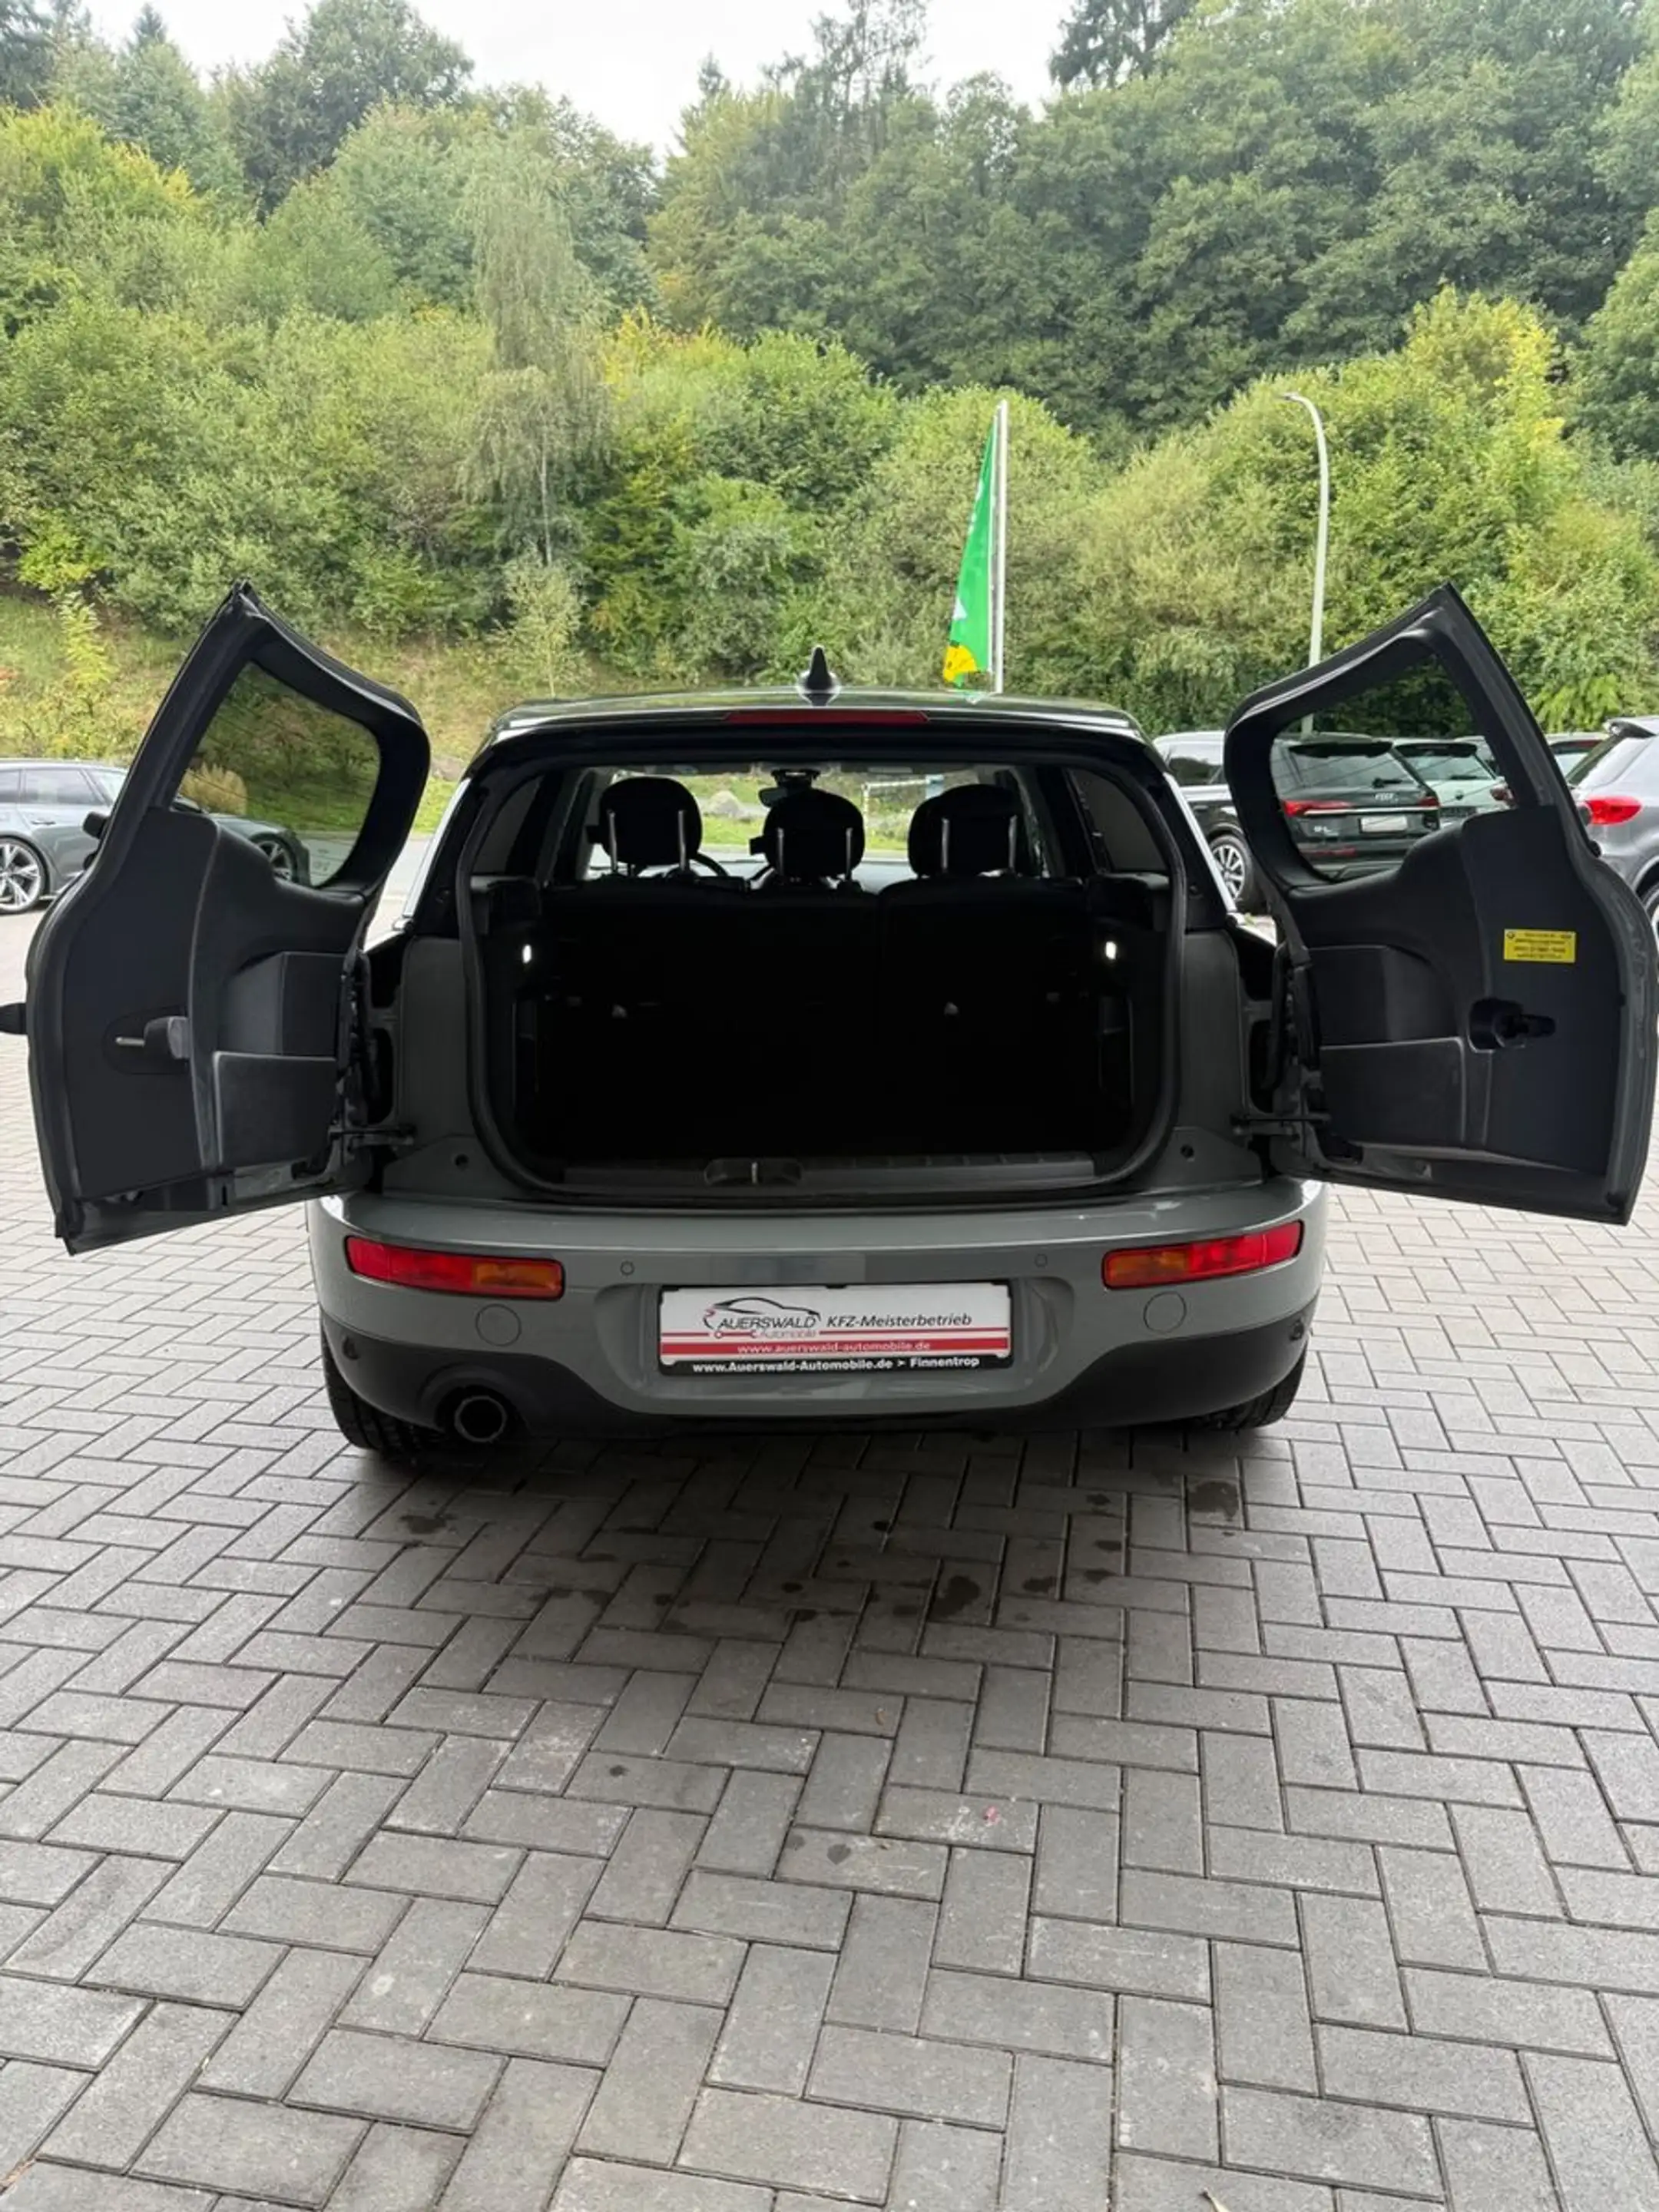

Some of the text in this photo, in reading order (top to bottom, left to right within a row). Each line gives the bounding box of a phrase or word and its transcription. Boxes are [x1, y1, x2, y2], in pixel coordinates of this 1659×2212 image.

[717, 1316, 816, 1330] AUERSWALD
[826, 1313, 972, 1328] KFZ-Meisterbetrieb
[737, 1342, 930, 1353] www.auerswald-automobile.de
[693, 1359, 893, 1373] www.Auerswald-Automobile.de
[910, 1356, 980, 1369] Finnentrop
